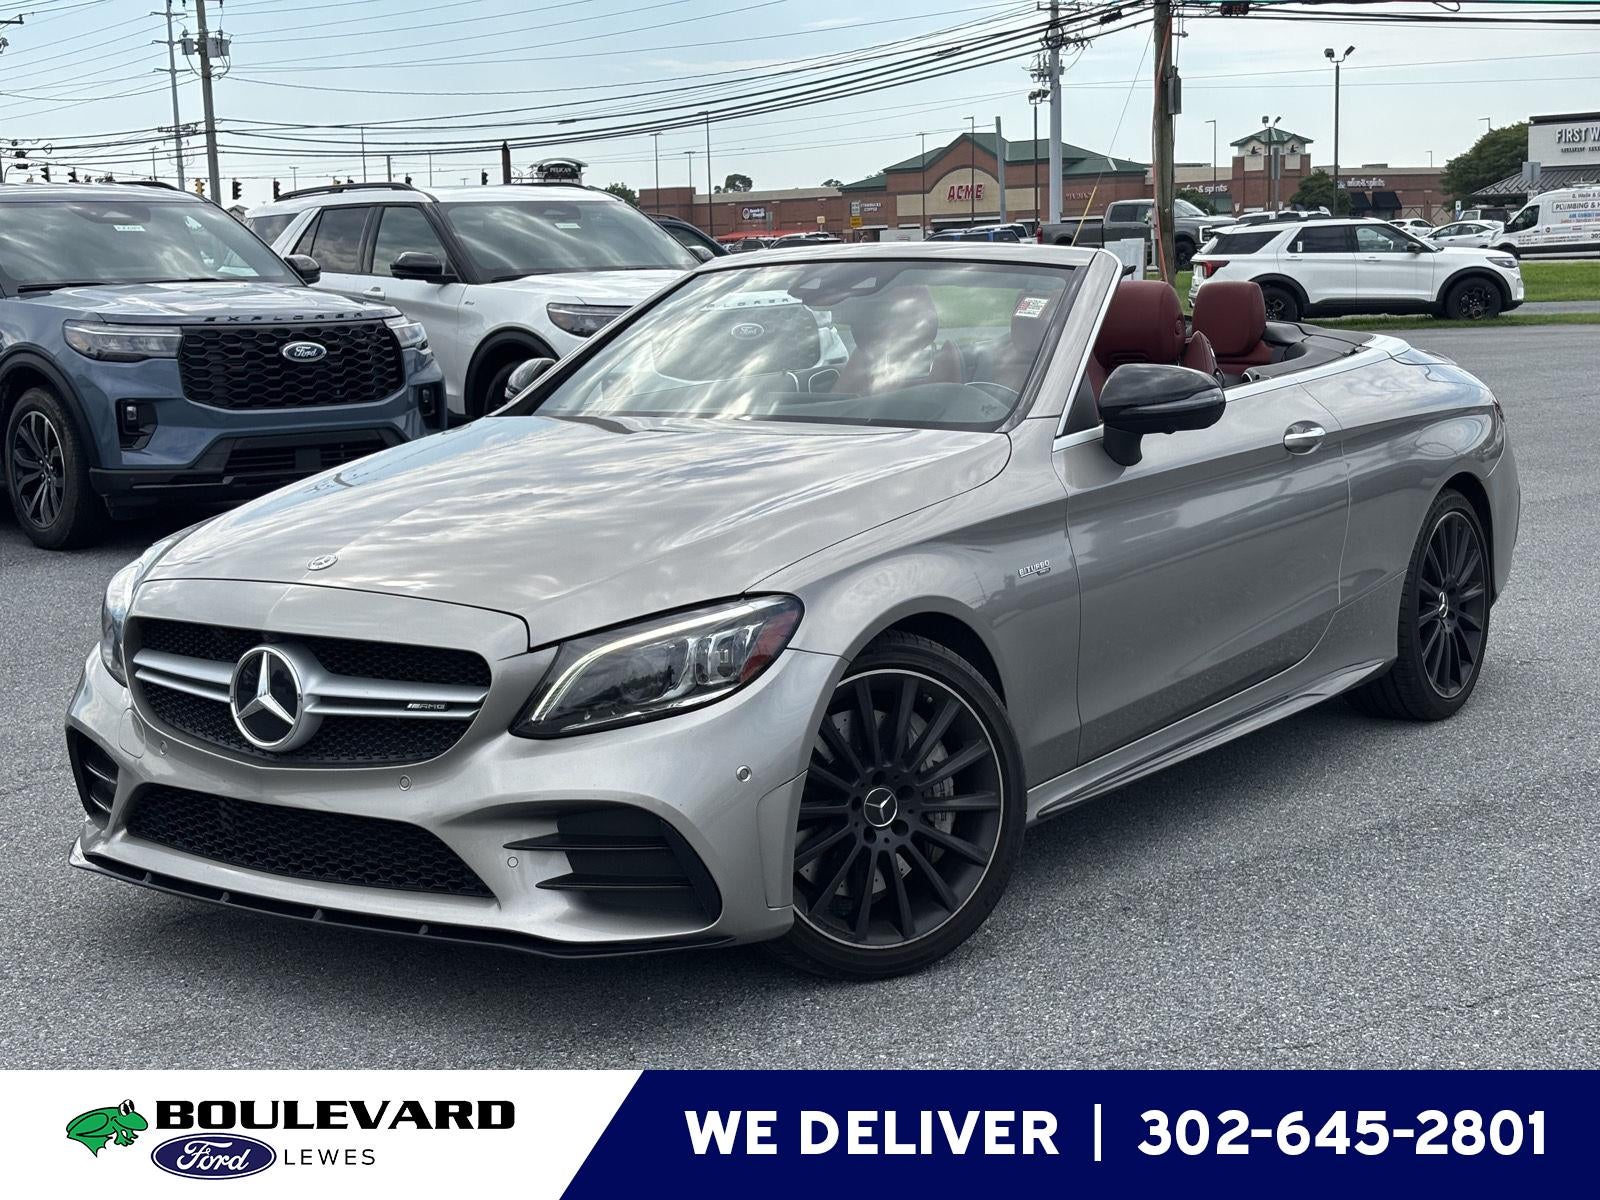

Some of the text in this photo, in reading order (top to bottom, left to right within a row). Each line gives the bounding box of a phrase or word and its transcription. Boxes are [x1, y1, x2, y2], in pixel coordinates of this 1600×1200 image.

[1556, 127, 1587, 143] FIRST
[947, 183, 984, 200] ACME
[1555, 202, 1589, 211] PLUMBING
[204, 312, 364, 322] EXPLORER
[294, 345, 318, 357] Ford
